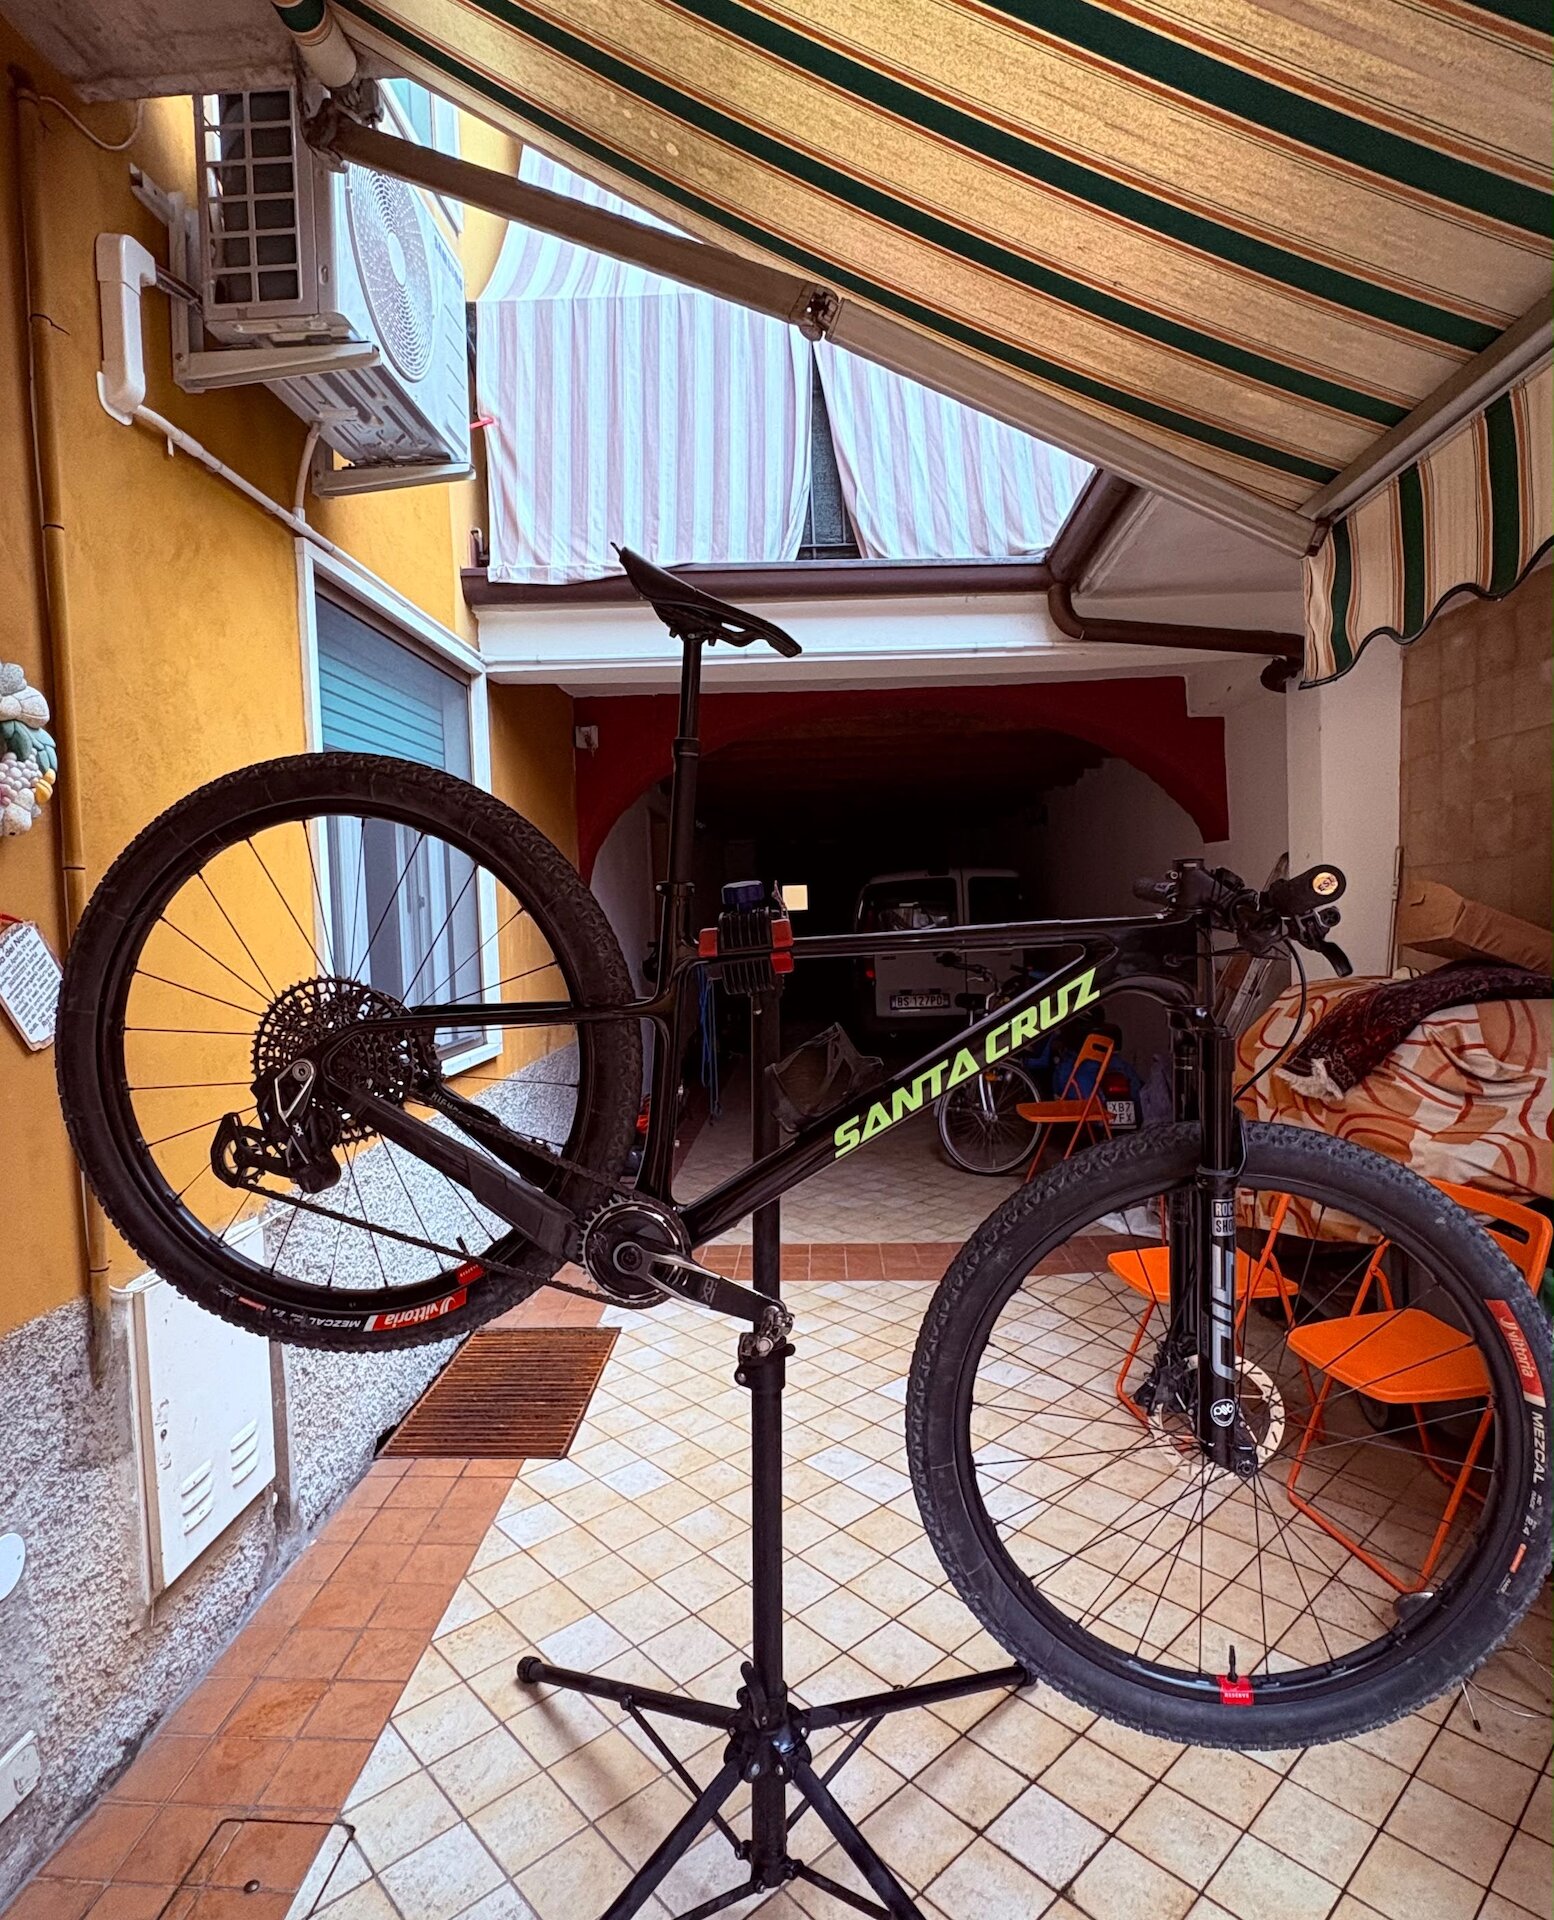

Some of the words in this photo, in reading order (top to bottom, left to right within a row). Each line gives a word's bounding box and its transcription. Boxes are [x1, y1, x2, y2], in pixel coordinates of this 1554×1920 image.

[834, 1048, 981, 1158] SANTA
[985, 967, 1100, 1064] CRUZ
[308, 1317, 362, 1328] MEZCAL
[384, 1302, 438, 1327] vittoria
[1507, 1330, 1536, 1379] vittoria
[1531, 1411, 1546, 1484] MEZCAL
